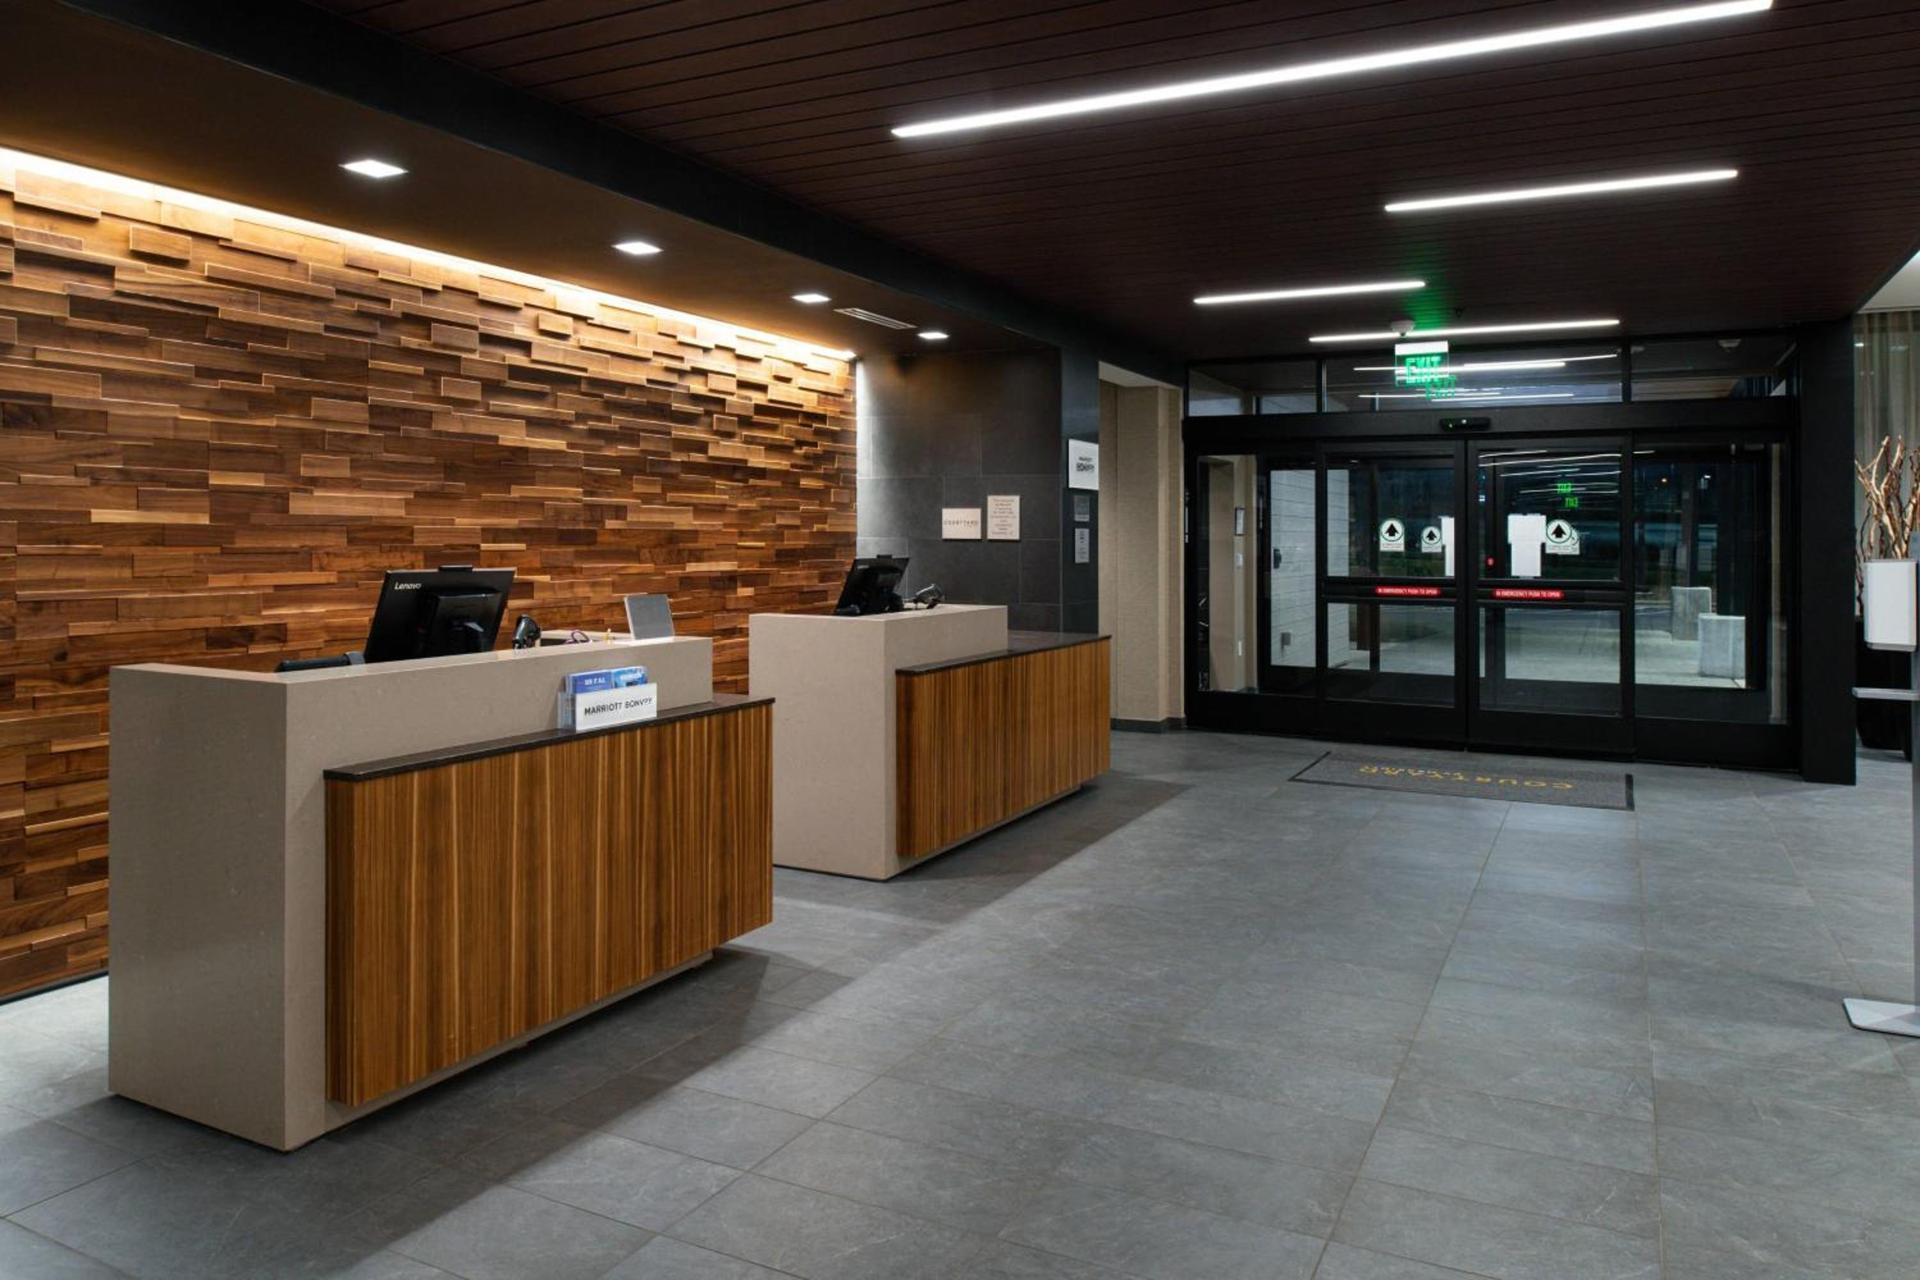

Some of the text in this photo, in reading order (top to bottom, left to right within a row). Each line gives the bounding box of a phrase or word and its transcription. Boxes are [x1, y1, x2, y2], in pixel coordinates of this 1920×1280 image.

[1406, 355, 1441, 384] EXIT
[394, 581, 422, 590] Lenovo
[584, 702, 622, 715] MARRIOTT
